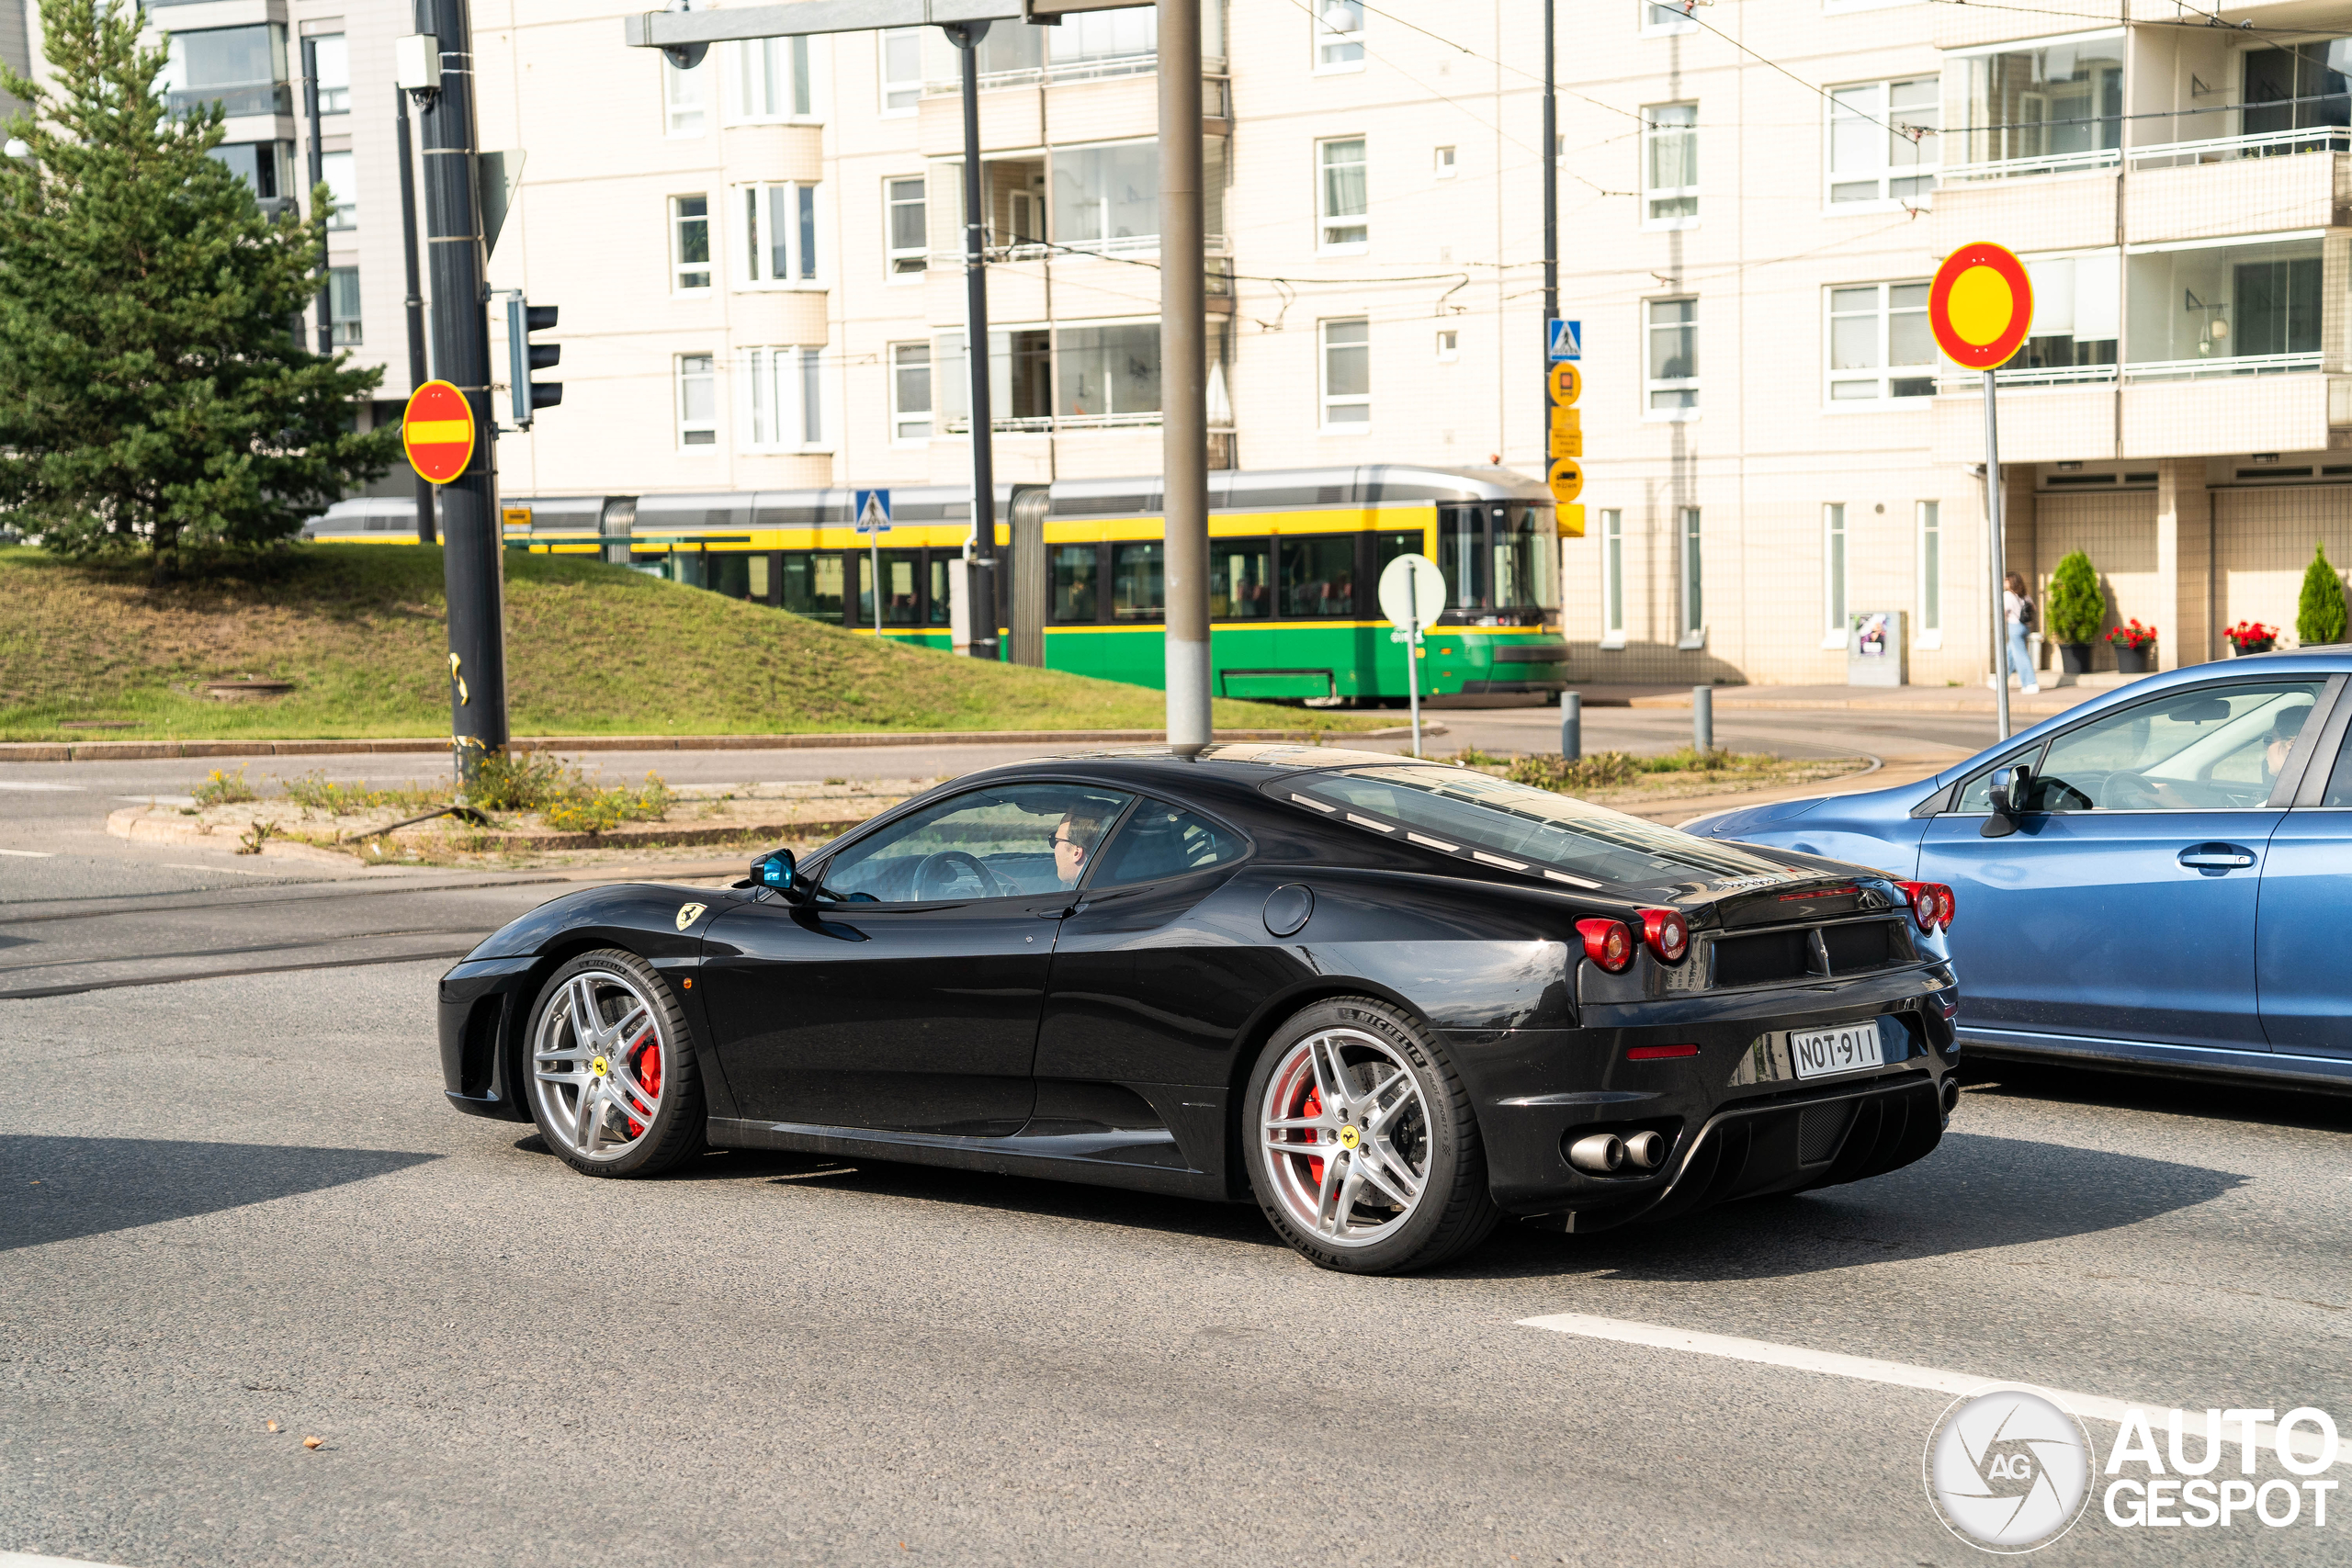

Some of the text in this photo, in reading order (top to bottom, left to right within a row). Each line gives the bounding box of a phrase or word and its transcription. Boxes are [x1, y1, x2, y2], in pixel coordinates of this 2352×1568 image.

[588, 960, 626, 974] MICHELIN
[1357, 1010, 1425, 1066] MICHELIN
[1797, 1029, 1875, 1071] NOT-911
[1426, 1072, 1441, 1096] PILOT
[1437, 1099, 1448, 1129] SPORT
[570, 1159, 607, 1173] MICHELIN
[1268, 1209, 1332, 1263] MICHELIN
